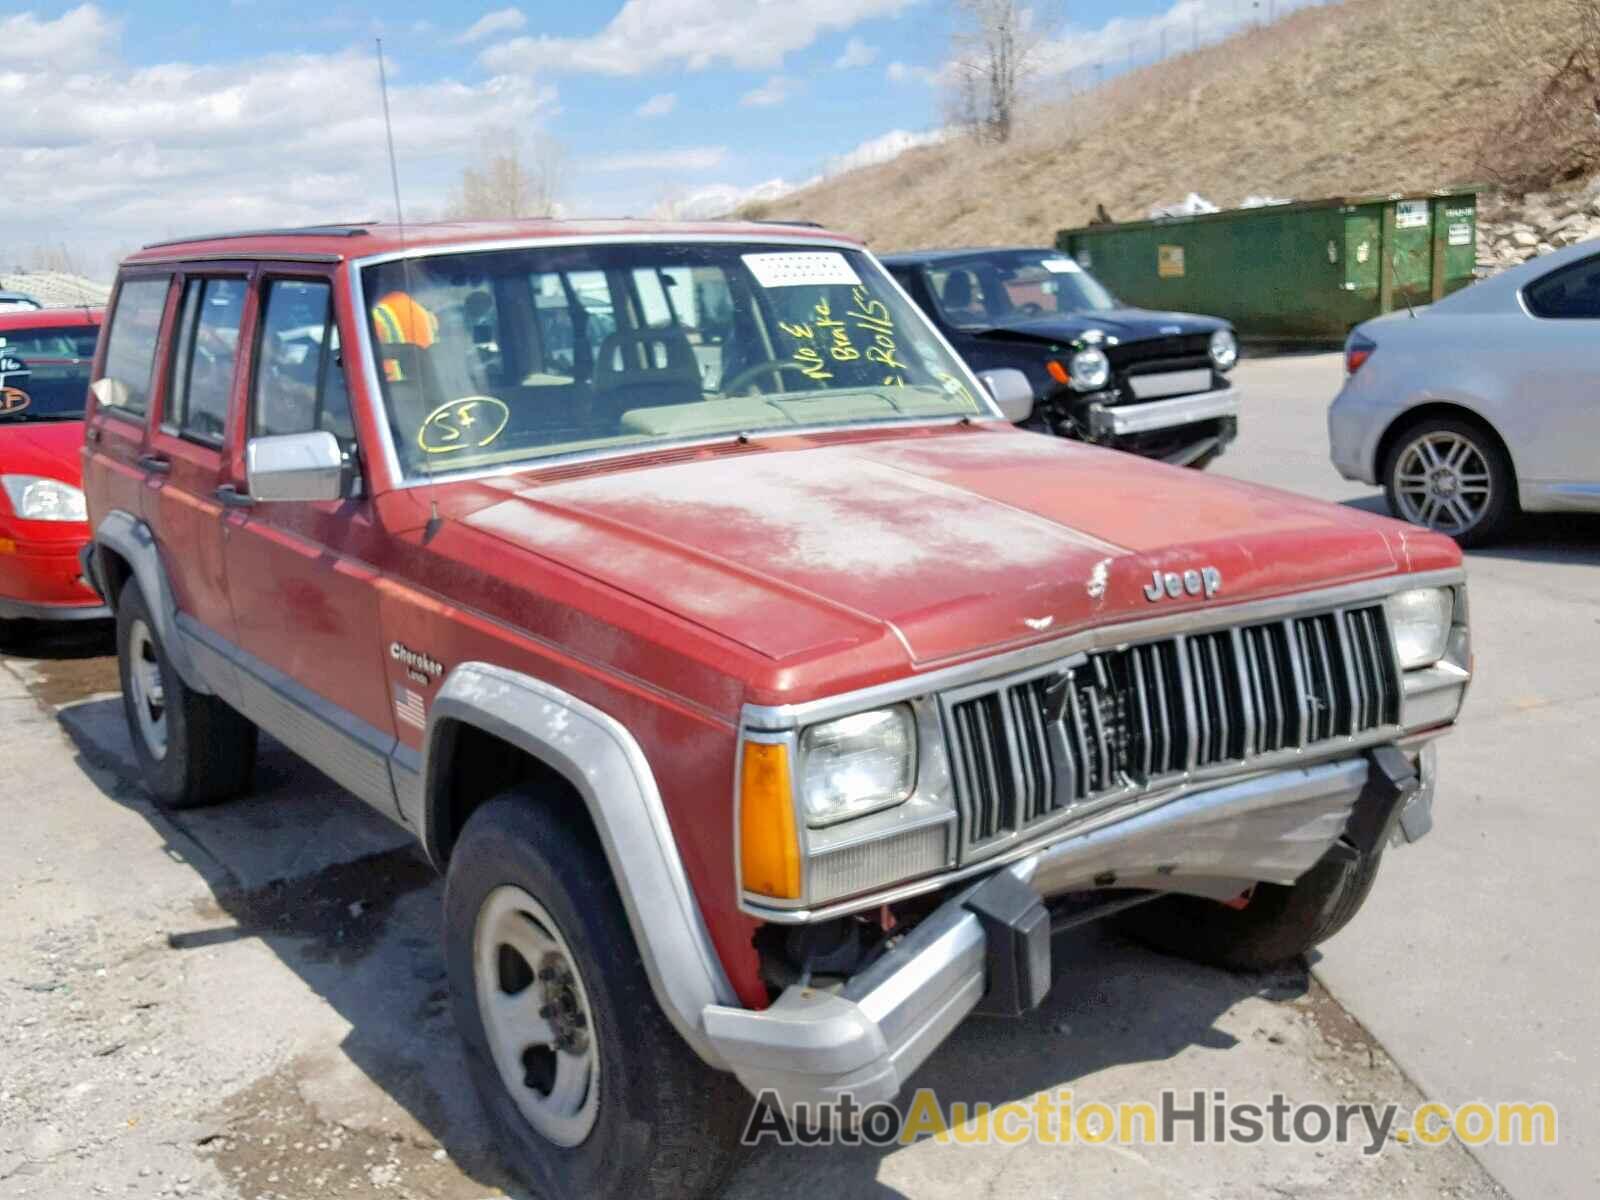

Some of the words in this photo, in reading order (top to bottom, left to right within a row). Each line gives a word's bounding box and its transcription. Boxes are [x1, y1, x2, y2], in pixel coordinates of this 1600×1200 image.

[793, 348, 833, 379] No
[1143, 566, 1222, 603] Jeep
[390, 641, 443, 677] Cherokee
